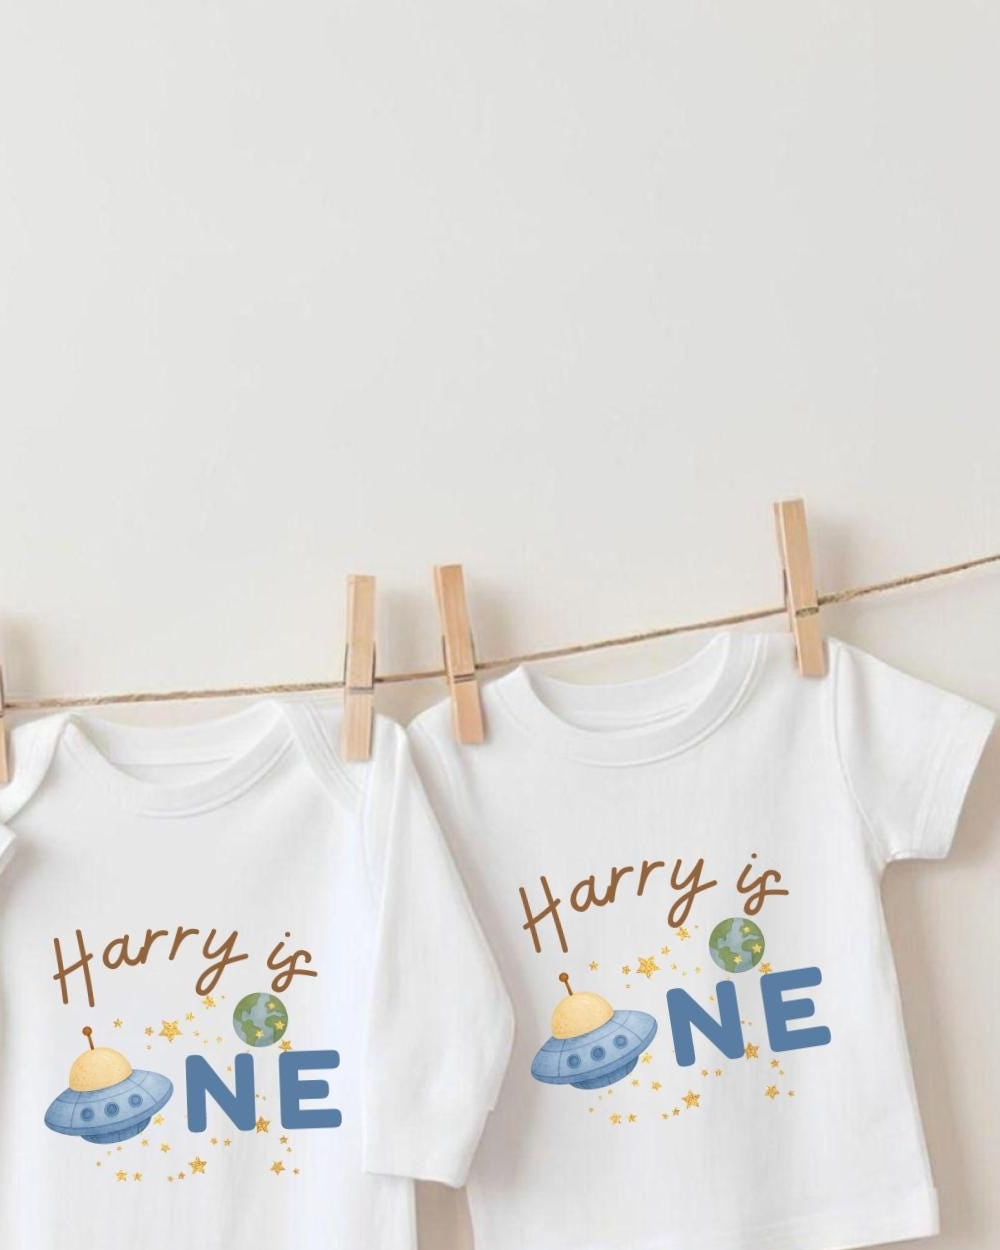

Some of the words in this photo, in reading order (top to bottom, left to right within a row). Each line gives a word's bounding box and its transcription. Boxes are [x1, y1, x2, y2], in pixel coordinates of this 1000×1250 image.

[519, 858, 718, 953] Harry
[736, 852, 790, 916] is
[53, 927, 249, 1008] Harry
[266, 930, 319, 993] is
